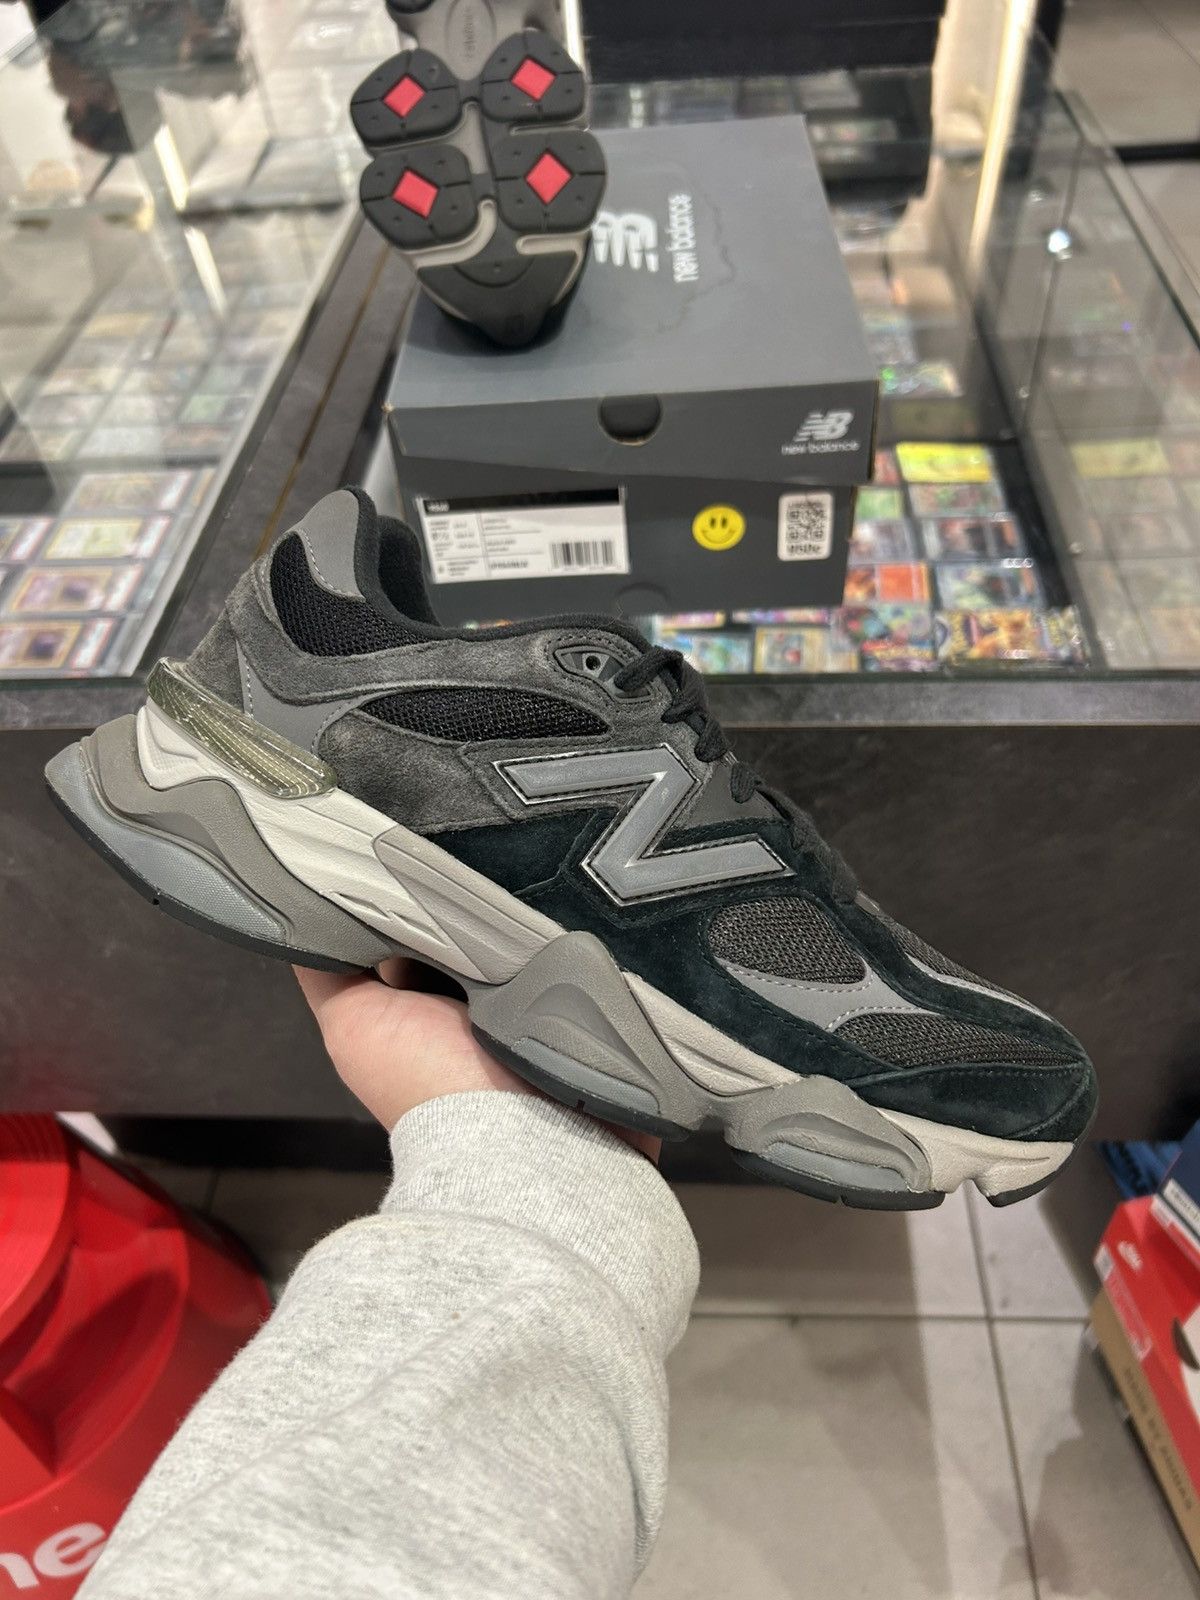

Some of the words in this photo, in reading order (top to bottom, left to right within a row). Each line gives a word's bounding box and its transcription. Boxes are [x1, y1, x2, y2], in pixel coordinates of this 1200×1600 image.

[665, 194, 697, 251] balance
[673, 252, 699, 282] new
[781, 443, 805, 456] new
[807, 440, 860, 454] balance
